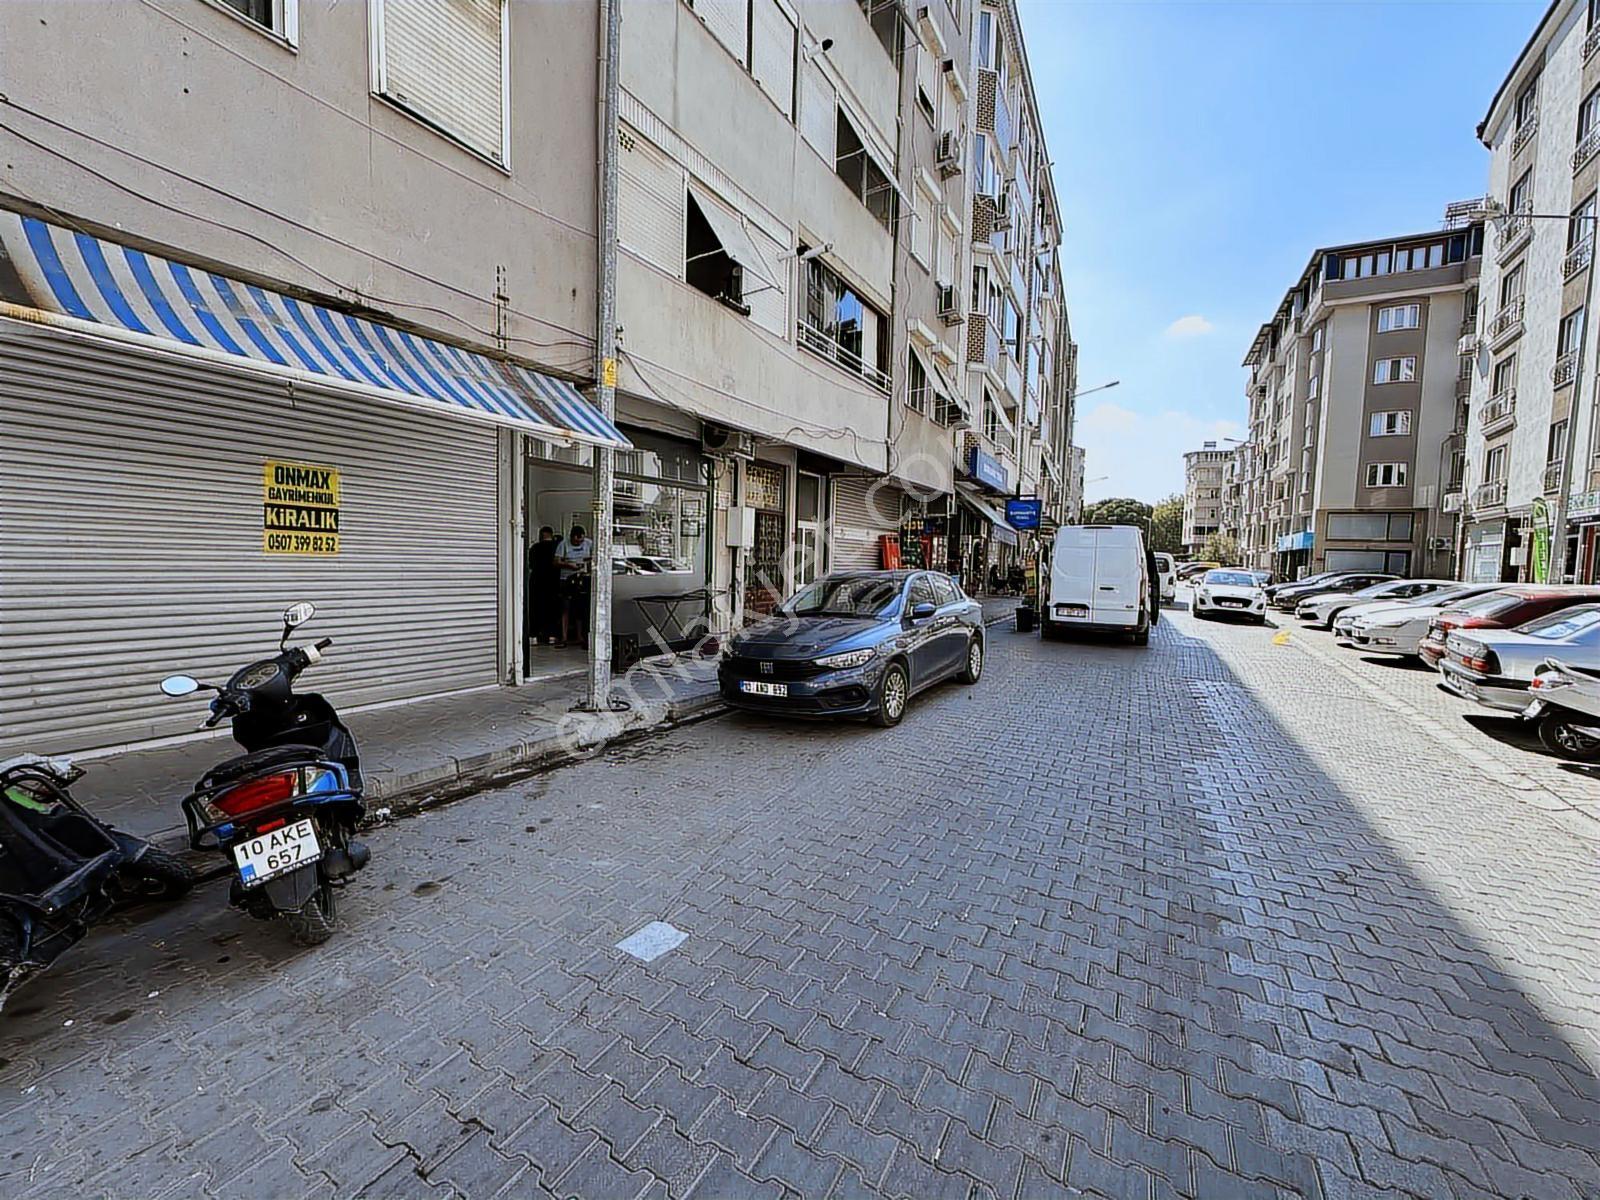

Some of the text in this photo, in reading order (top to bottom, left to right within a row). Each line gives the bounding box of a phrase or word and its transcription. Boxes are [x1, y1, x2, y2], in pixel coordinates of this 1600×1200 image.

[274, 465, 331, 489] ONMAX
[268, 534, 292, 550] 0507
[294, 536, 311, 551] 399
[240, 821, 311, 860] 10 AKE
[267, 844, 302, 869] 657
